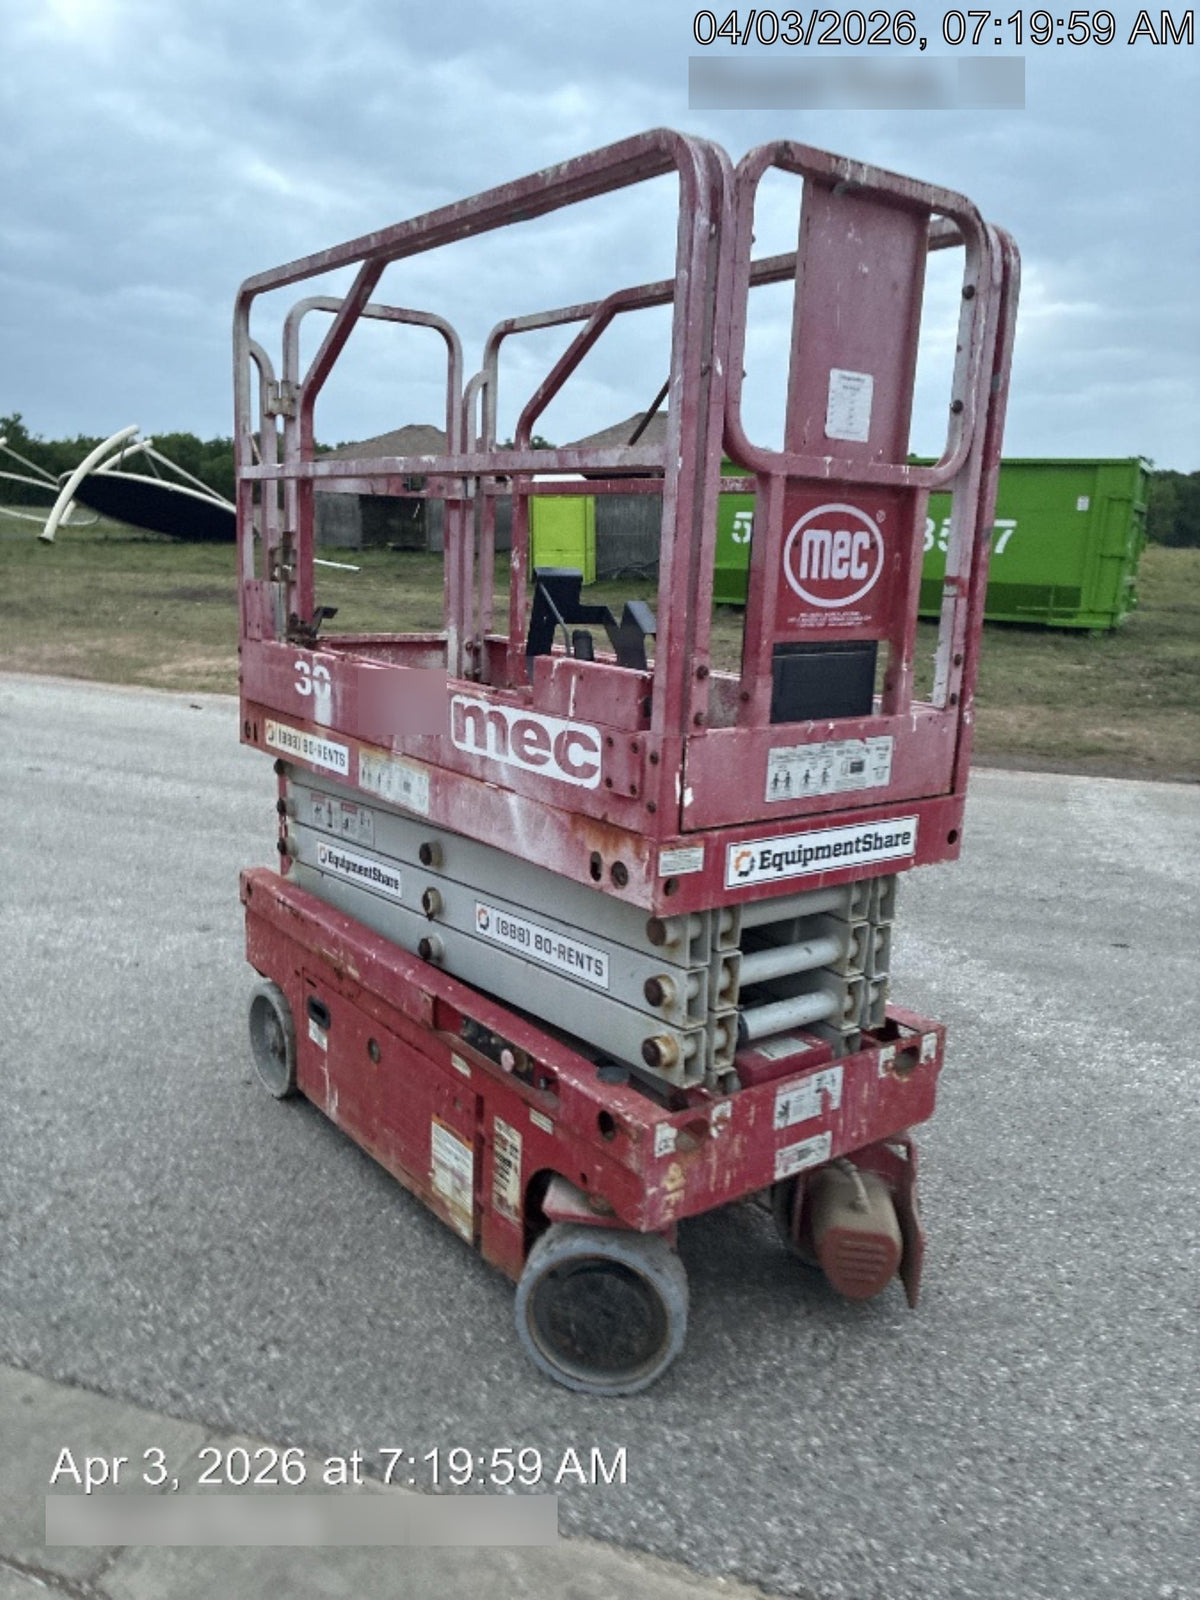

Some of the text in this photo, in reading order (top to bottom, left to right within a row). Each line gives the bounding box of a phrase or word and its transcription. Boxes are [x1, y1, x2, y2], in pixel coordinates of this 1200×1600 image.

[452, 700, 601, 780] mec
[327, 850, 400, 891] EquipmentShare
[758, 830, 912, 871] EquipmentShare
[495, 916, 604, 978] (888) 80-RENTS
